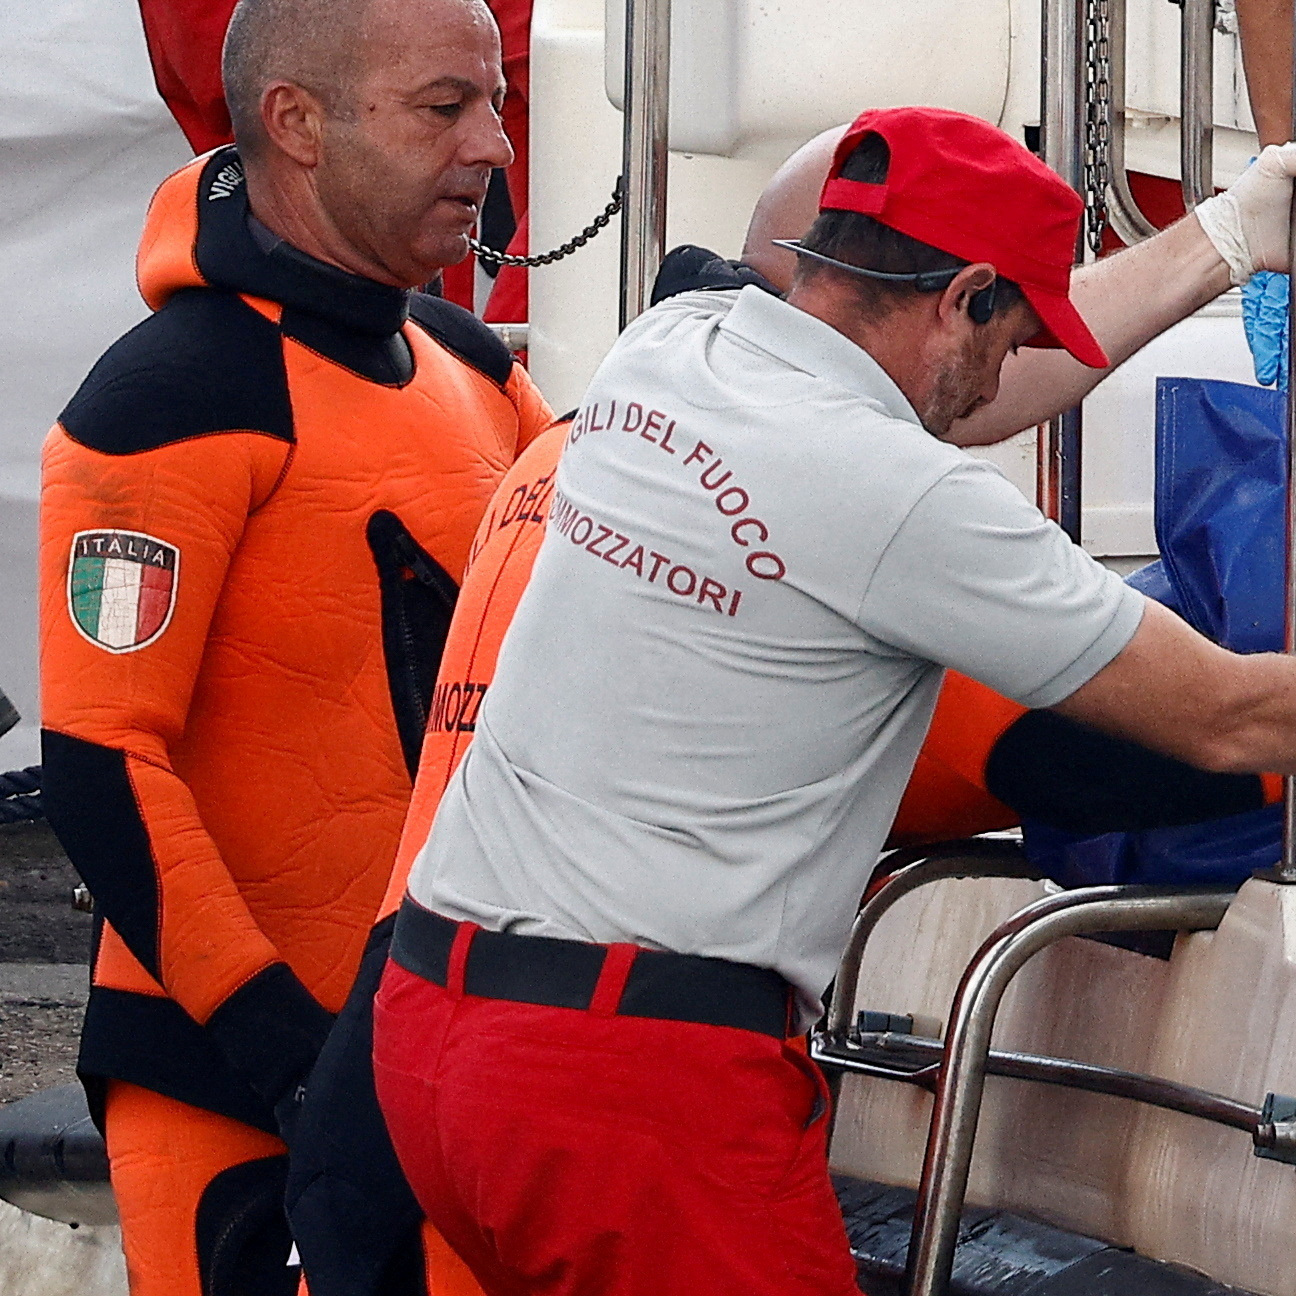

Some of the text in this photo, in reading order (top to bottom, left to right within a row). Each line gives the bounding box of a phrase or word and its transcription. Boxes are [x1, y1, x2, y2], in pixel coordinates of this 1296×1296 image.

[81, 538, 165, 566] ITALIA
[549, 490, 742, 617] OMMOZZATORI
[564, 399, 787, 581] GILI DEL FUOCO
